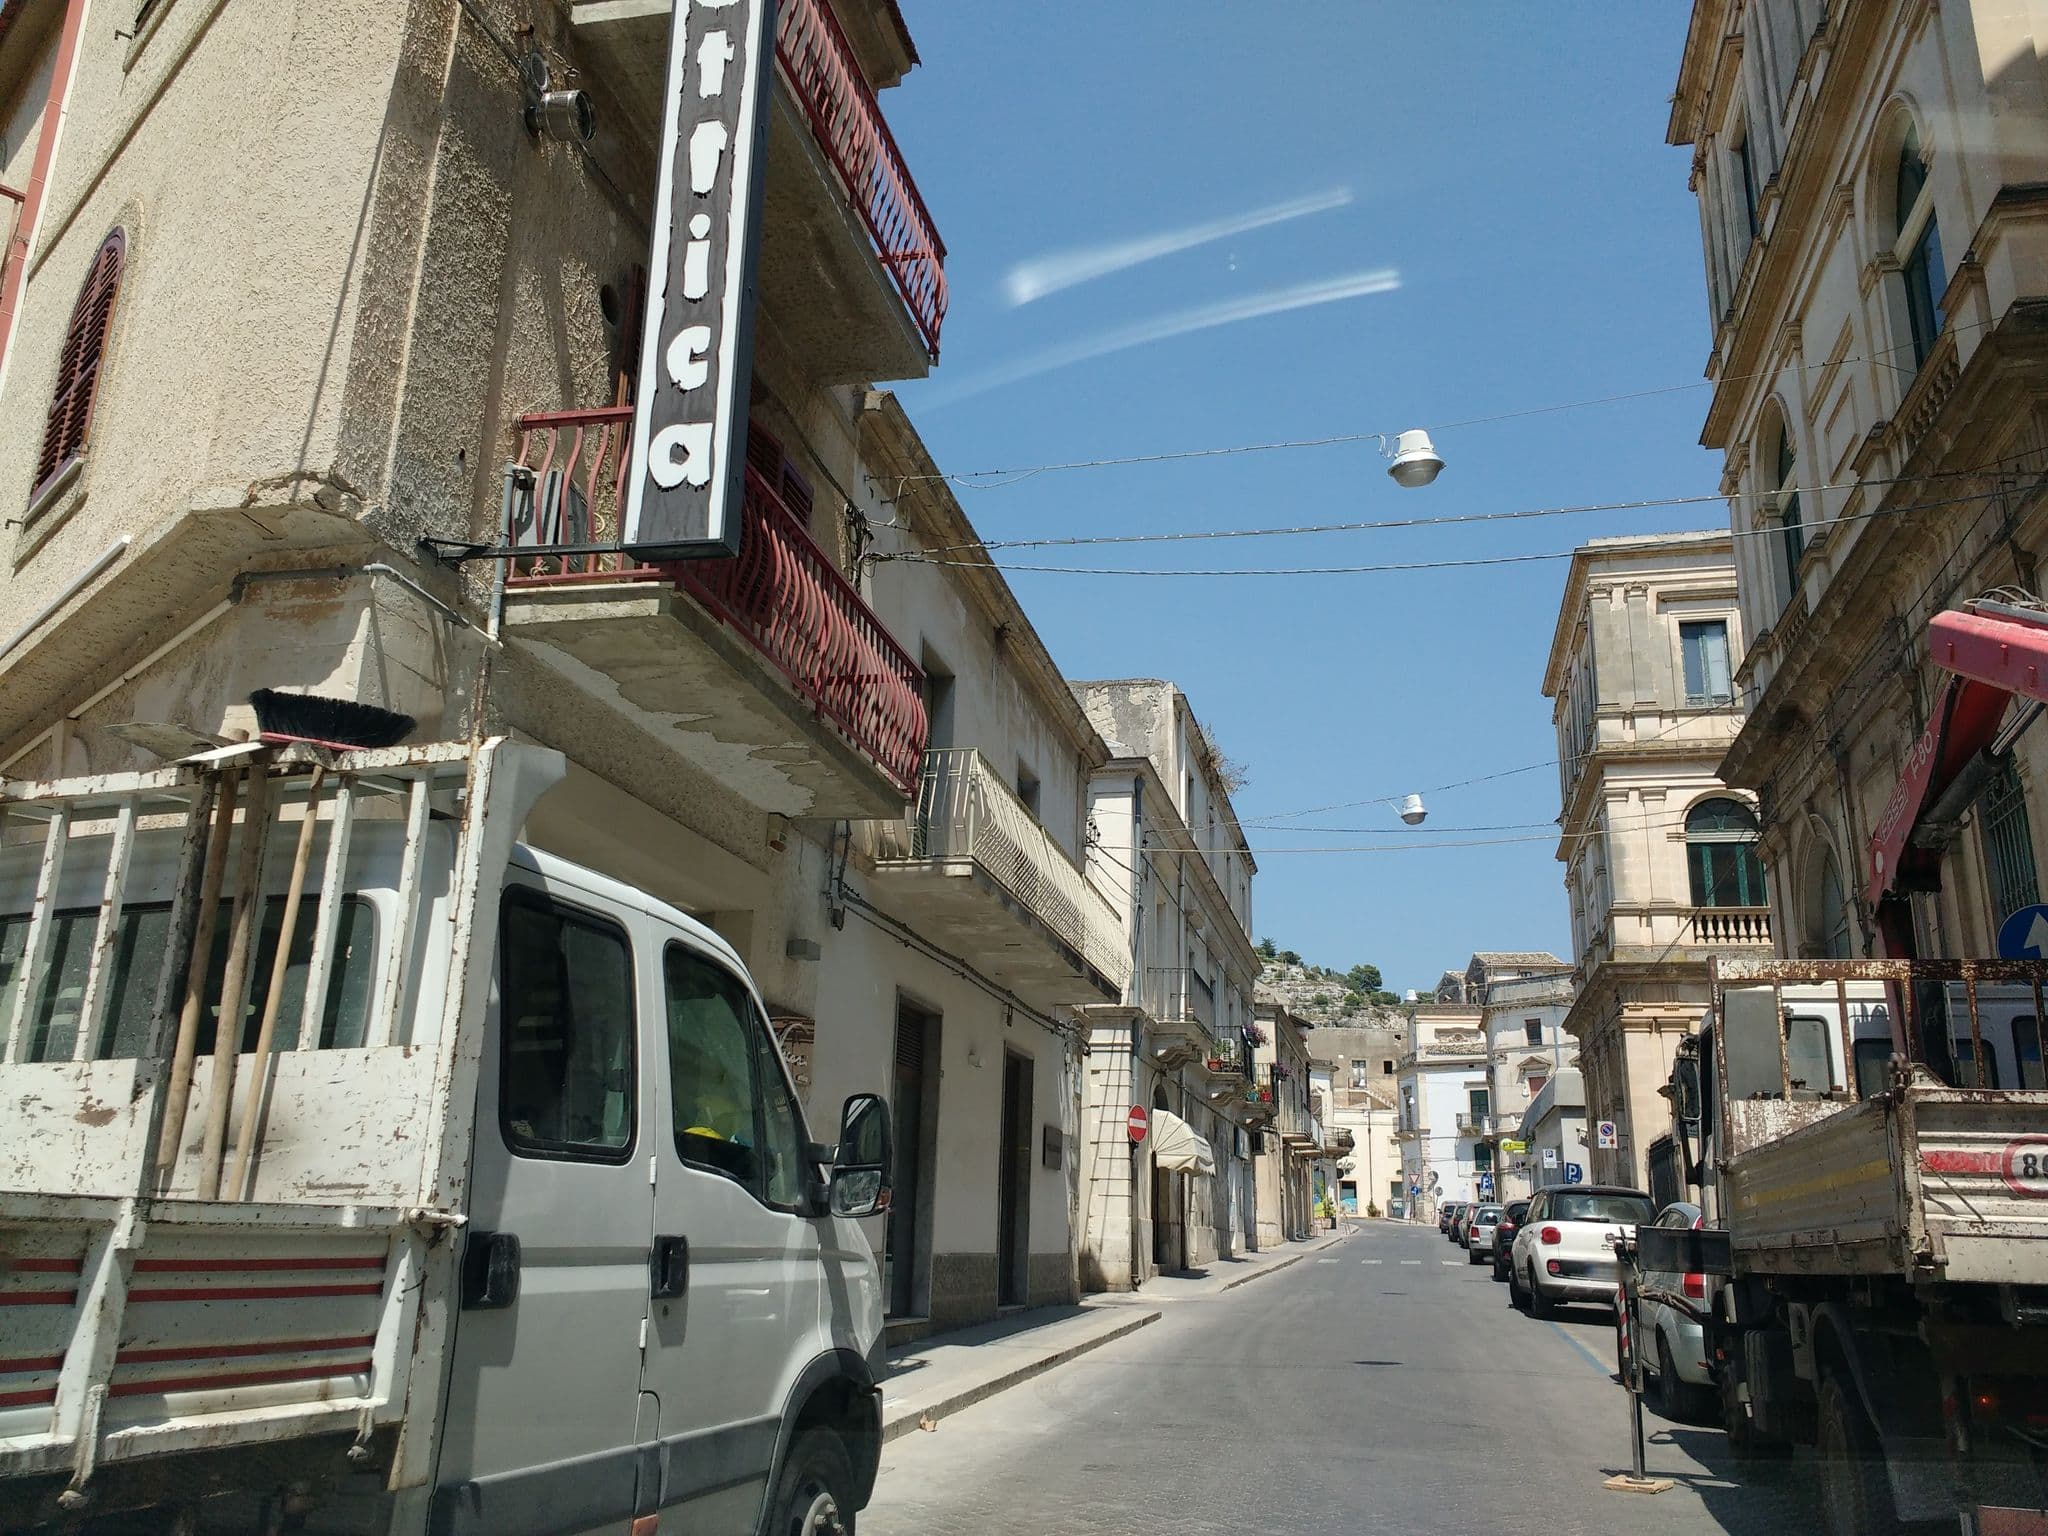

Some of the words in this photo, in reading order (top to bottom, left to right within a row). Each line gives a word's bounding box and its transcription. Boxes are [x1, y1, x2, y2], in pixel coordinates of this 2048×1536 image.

[648, 0, 740, 491] ttica
[1911, 730, 1932, 779] F80
[1881, 781, 1907, 840] FASSI
